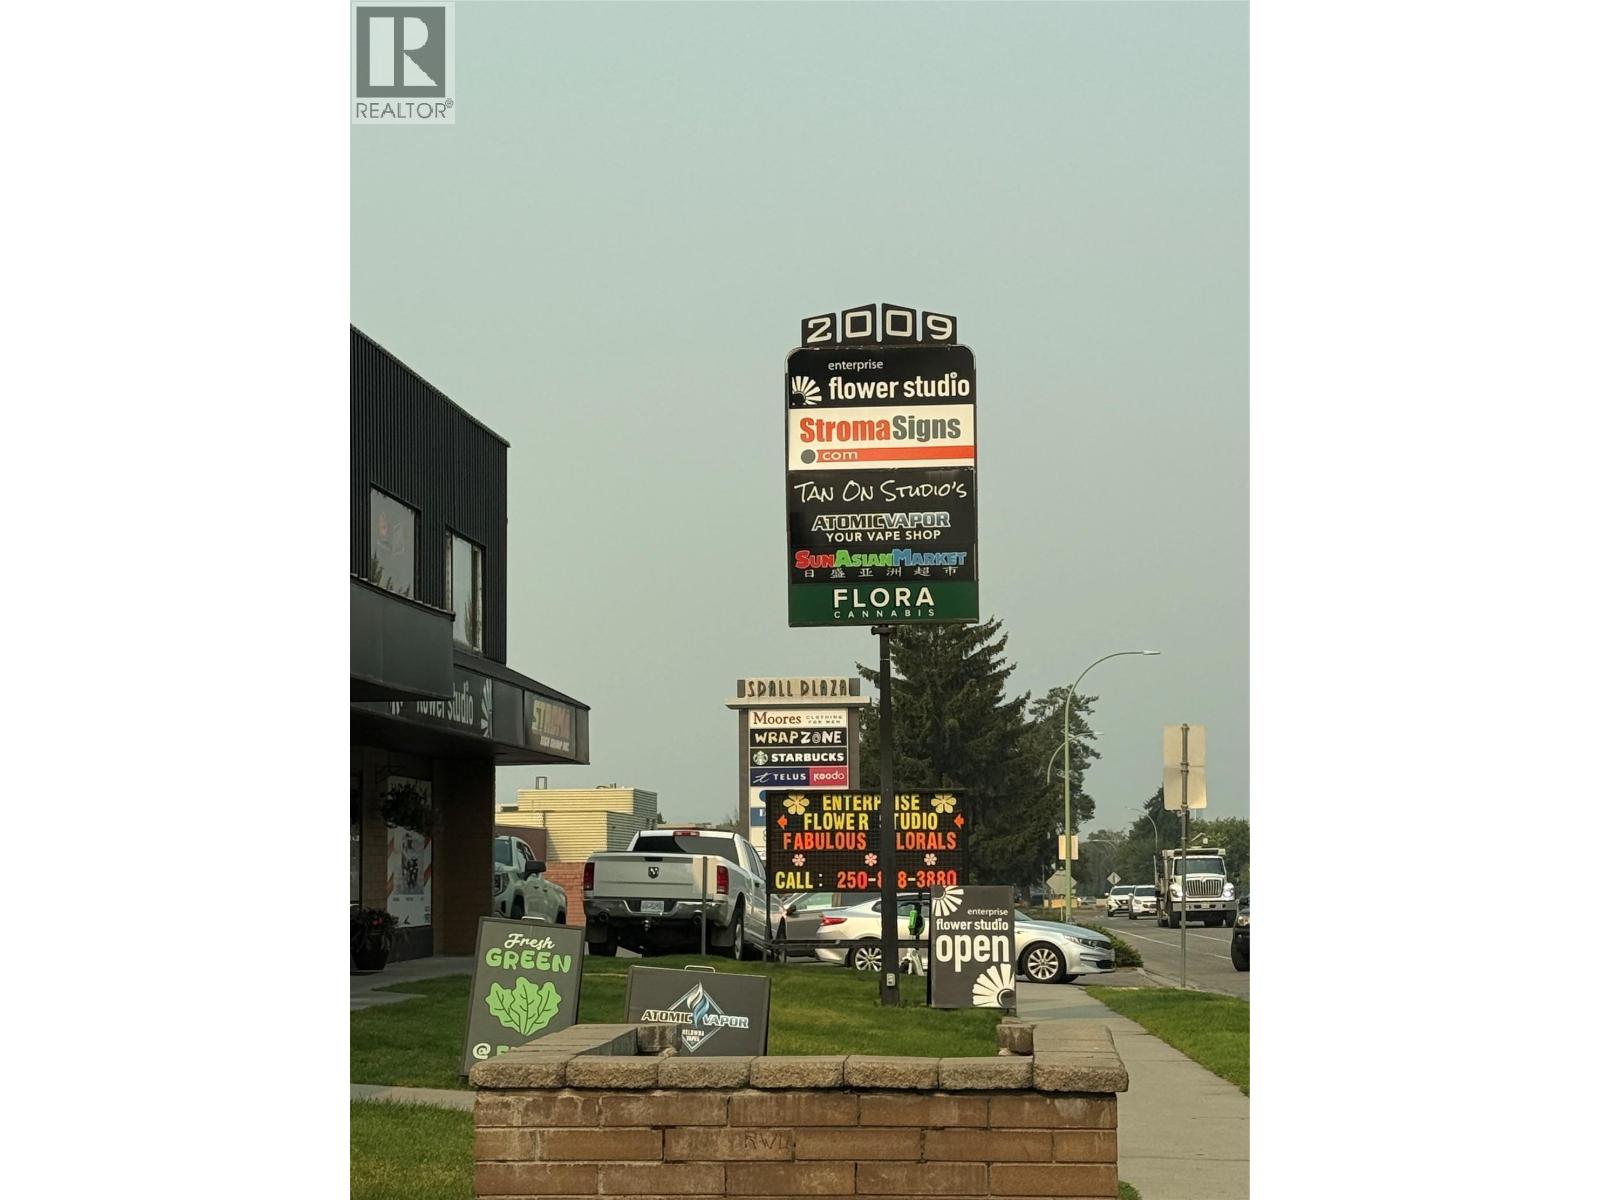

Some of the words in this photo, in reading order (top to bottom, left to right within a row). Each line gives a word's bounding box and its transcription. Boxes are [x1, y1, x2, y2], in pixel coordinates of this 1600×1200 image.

[807, 309, 953, 344] 2009
[827, 359, 884, 373] enterprise
[828, 376, 899, 400] flower
[903, 372, 970, 398] studio
[799, 415, 961, 443] StromaSigns
[811, 512, 951, 531] ATOMICVAPOR
[826, 532, 863, 543] YOUR
[867, 531, 901, 542] VAPE
[906, 530, 941, 541] SHOP
[833, 587, 935, 608] FLORA
[834, 609, 935, 619] CANNABIS
[747, 680, 793, 697] SPALL
[800, 679, 847, 696] PLAZA
[753, 711, 802, 725] Moores
[771, 752, 845, 763] STARBUCKS
[773, 773, 807, 781] TELUS
[823, 794, 920, 811] ENTERPISE
[803, 812, 869, 831] FLOWER
[879, 812, 938, 830] TUDIO
[783, 832, 867, 850] FABULOUS
[896, 832, 957, 850] LORALS
[775, 871, 813, 889] CALL
[968, 908, 1009, 917] enterprise
[936, 919, 972, 931] flower
[974, 918, 1009, 931] studio
[504, 933, 555, 951] Fresh
[485, 948, 572, 973] GREEN
[936, 934, 1010, 972] open
[641, 1009, 694, 1024] ATOMIC
[702, 1014, 749, 1028] VAPOR
